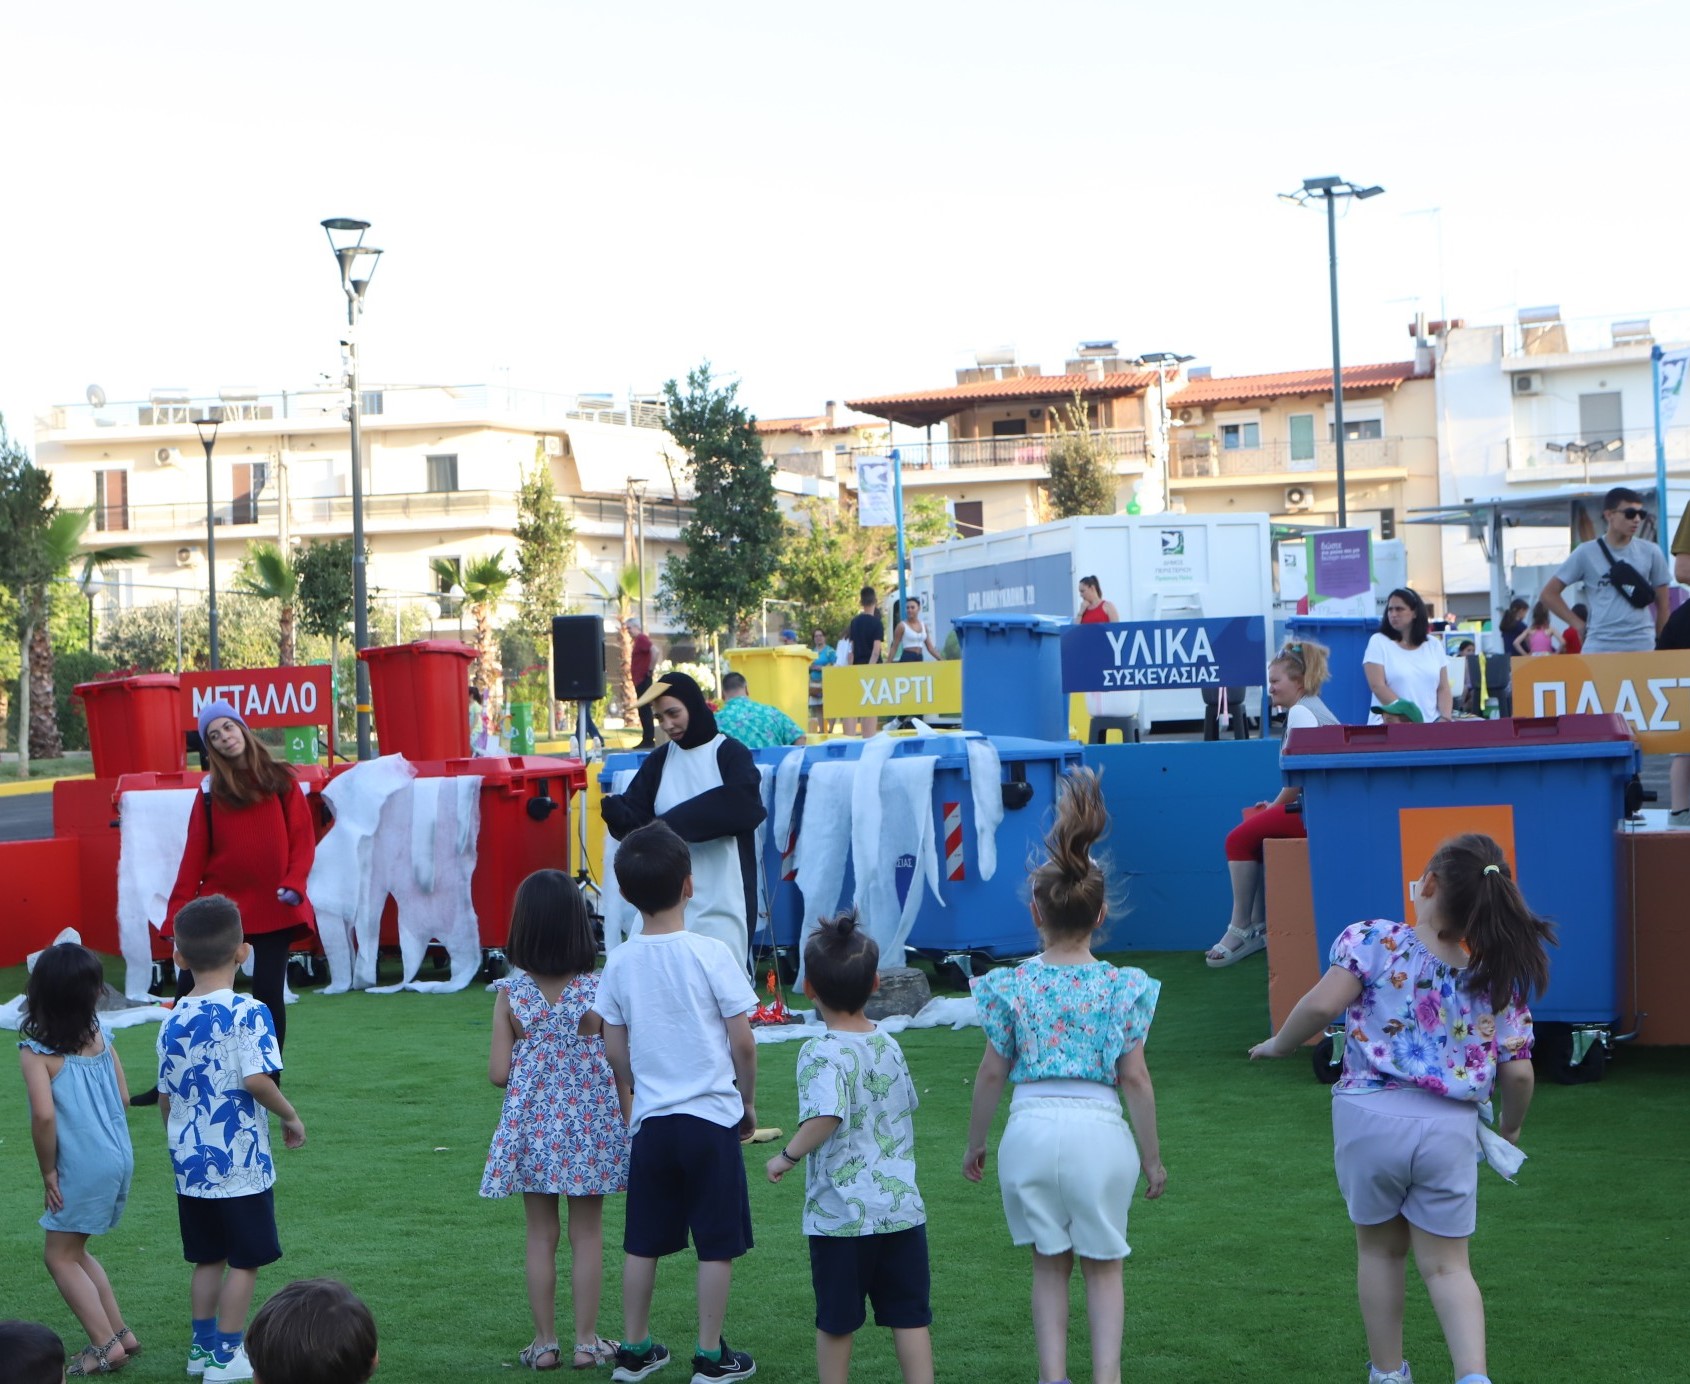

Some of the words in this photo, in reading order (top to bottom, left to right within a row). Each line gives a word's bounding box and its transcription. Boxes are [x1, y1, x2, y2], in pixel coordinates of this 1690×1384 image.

[1105, 626, 1216, 667] ΥΛΙΚΑ
[859, 675, 935, 706] ΧΑΡΤΙ
[1102, 665, 1221, 687] ΣΥΣΚΕΥΑΣΙΑΣ
[1533, 677, 1690, 731] ΠΛΑΣ
